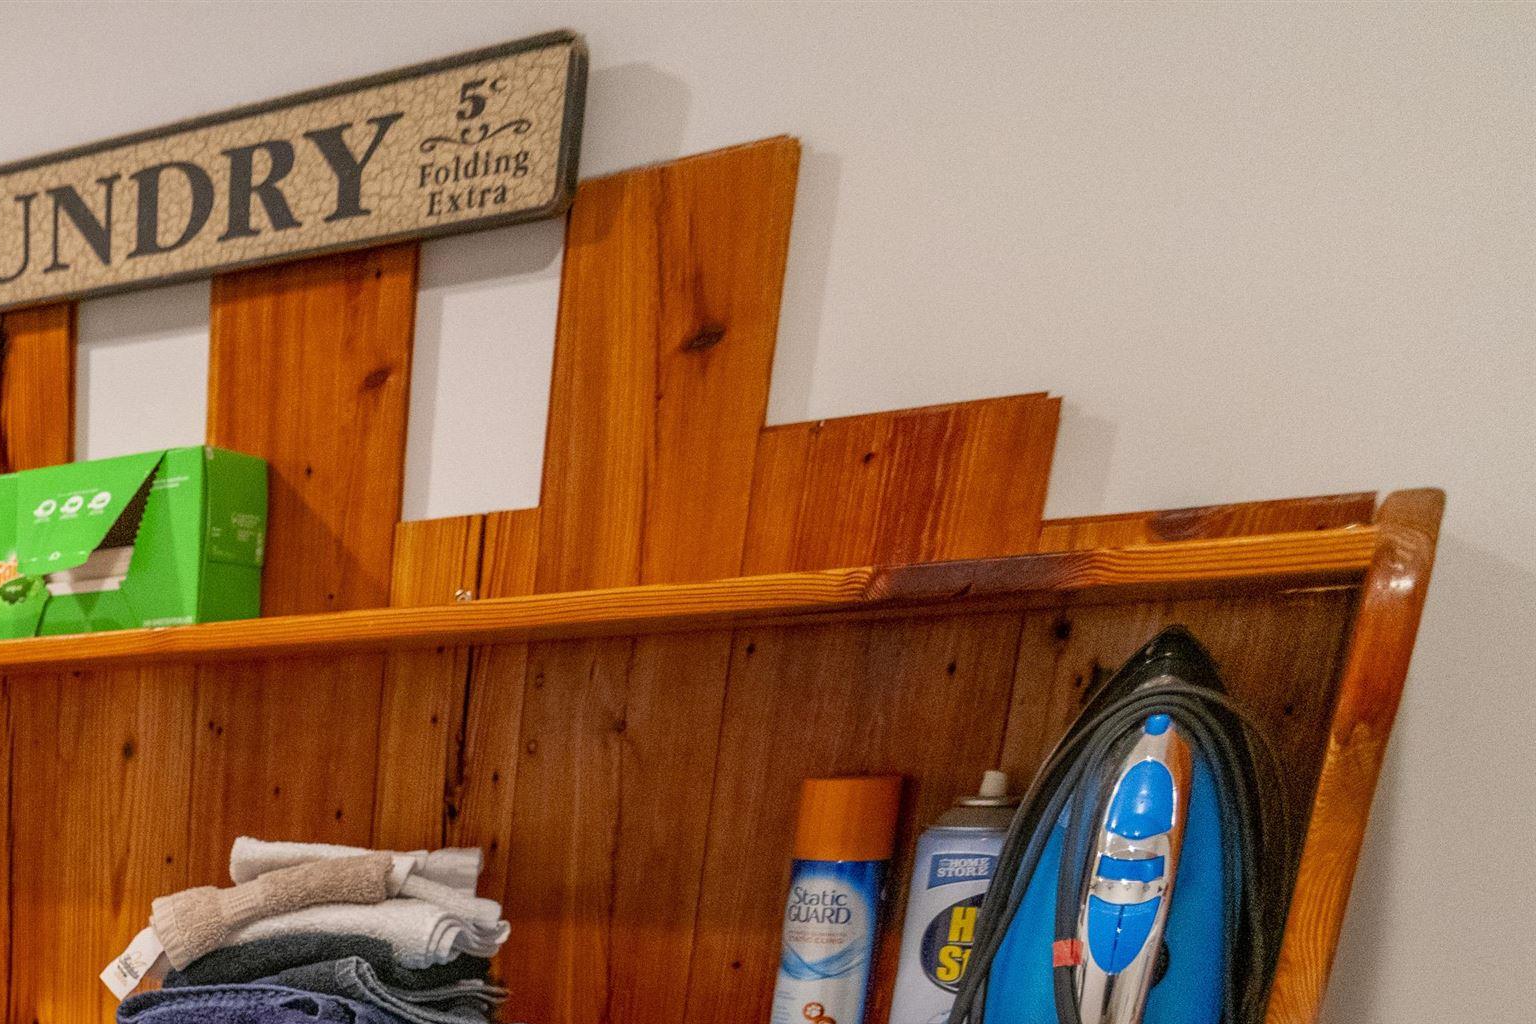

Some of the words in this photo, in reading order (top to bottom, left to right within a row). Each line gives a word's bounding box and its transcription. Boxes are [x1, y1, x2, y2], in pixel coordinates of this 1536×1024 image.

[419, 149, 530, 189] Folding
[426, 184, 507, 216] Extra
[936, 866, 989, 878] STORE
[948, 858, 990, 869] HOME
[794, 886, 848, 907] Static
[788, 904, 851, 925] GUARD
